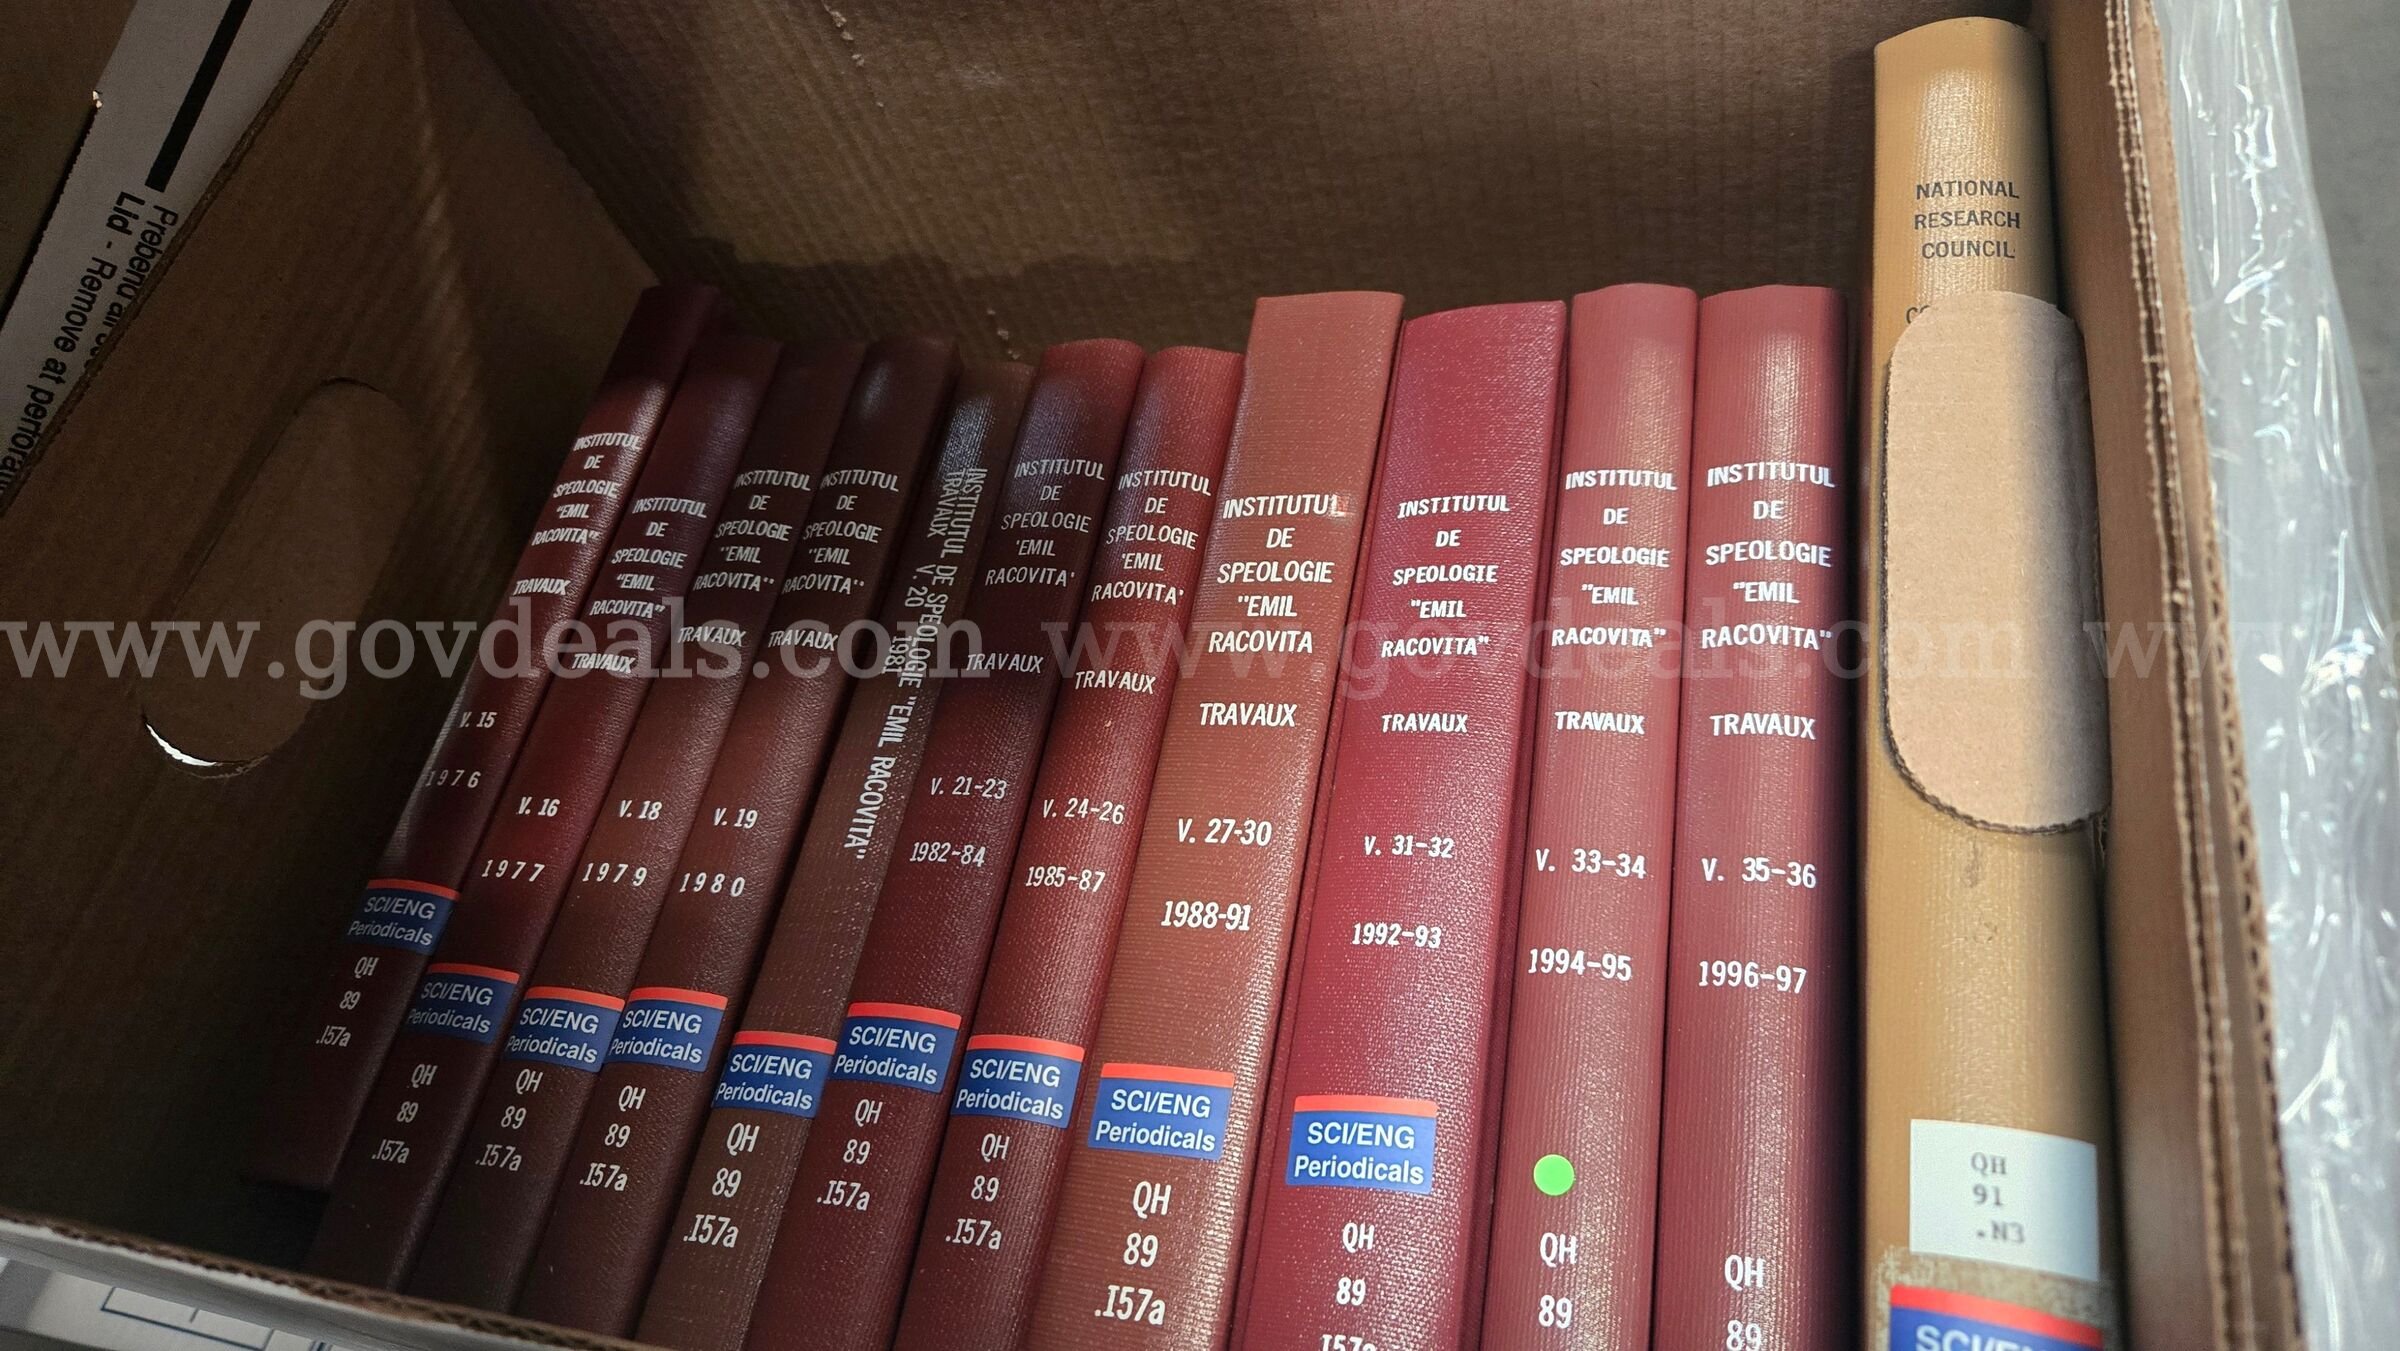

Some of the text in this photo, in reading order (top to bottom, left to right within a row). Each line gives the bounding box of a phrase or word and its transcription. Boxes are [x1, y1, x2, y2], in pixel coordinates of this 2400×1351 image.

[1916, 180, 2020, 200] NATIONAL
[106, 191, 146, 236] Lid
[1914, 210, 2021, 230] RESEARCH
[117, 205, 178, 300] Prebend
[1921, 240, 2016, 259] COUNCIL
[54, 257, 118, 352] Remove
[39, 357, 67, 385] at
[573, 432, 641, 451] INSTITUTUL
[584, 455, 602, 469] DE
[1014, 458, 1105, 481] INSTITUTUL
[1707, 461, 1835, 488] INSTITUTUL
[552, 480, 620, 499] SPEOLOGIE
[734, 469, 811, 491] INSTITUTUL
[820, 470, 898, 492] INSTITUTUL
[1118, 470, 1211, 496] INSTITUTUL
[1565, 469, 1678, 490] INSTITUTUL
[751, 494, 771, 510] DE
[836, 494, 857, 511] DE
[1040, 485, 1062, 501] DE
[1144, 497, 1168, 514] DE
[632, 497, 707, 519] INSTITUTUL
[940, 468, 987, 558] INSTITUTUL
[1222, 494, 1346, 520] INSTITUTUL
[1397, 494, 1510, 520] INSTITUTUL
[1603, 507, 1630, 525] DE
[1753, 500, 1785, 520] DE
[646, 522, 668, 537] DE
[715, 520, 793, 542] SPEOLOGIE
[803, 520, 881, 543] SPEOLOGIE
[1001, 512, 1091, 533] SPEOLOGIE
[904, 469, 966, 608] TRAVAUX 20
[1106, 524, 1199, 550] SPEOLOGIE
[1266, 528, 1294, 549] DE
[1435, 529, 1461, 548] DE
[611, 548, 687, 568] SPEOLOGIE
[1560, 546, 1671, 568] SPEOLOGIE
[1705, 540, 1832, 568] SPEOLOGIE
[935, 564, 958, 586] DE
[1216, 560, 1335, 584] SPEOLOGIE
[1392, 564, 1499, 586] SPEOLOGIE
[513, 579, 569, 596] TRAVAUX
[677, 626, 746, 647] TRAVAUX
[767, 630, 838, 651] TRAVAUX
[898, 593, 948, 688] SPEOLOGIE
[571, 653, 636, 673] TRAVAUX
[966, 653, 1043, 673] TRAVAUX
[1075, 670, 1156, 695] TRAVAUX
[459, 711, 497, 728] V. 15
[1200, 702, 1298, 727] TRAVAUX
[1381, 714, 1468, 733] TRAVAUX
[1555, 710, 1645, 735] TRAVAUX
[1710, 712, 1816, 740] TRAVAUX
[425, 769, 481, 789] 1976
[931, 776, 1007, 800] V. 21-23
[518, 797, 560, 817] V. 16
[618, 800, 662, 820] V. 18
[713, 808, 758, 829] V. 19
[1043, 798, 1125, 825] V. 24-26
[1177, 818, 1273, 847] V. 27-30
[910, 842, 986, 867] 1982-84
[1364, 834, 1455, 859] V. 31-32
[482, 859, 545, 882] 1977
[582, 863, 648, 887] 1979
[1535, 847, 1647, 880] V. 33-34
[1701, 856, 1817, 889] V. 35-36
[679, 872, 745, 897] 1980
[1026, 866, 1106, 893] 1985-87
[364, 897, 436, 920] SCI/ENG
[1160, 900, 1252, 932] 1988-91
[349, 921, 433, 946] Periodicals
[1351, 922, 1442, 949] 1992-93
[354, 957, 378, 978] QH
[1528, 948, 1632, 982] 1994-95
[1698, 960, 1807, 994] 1996-97
[339, 991, 360, 1010] 89
[421, 982, 493, 1006] SCI/ENG
[407, 1008, 490, 1034] Periodicals
[520, 1008, 599, 1035] SCI/ENG
[623, 1009, 702, 1035] SCI/ENG
[506, 1034, 597, 1064] Periodicals
[609, 1038, 702, 1064] Periodicals
[849, 1026, 936, 1054] SCI/ENG
[411, 1064, 437, 1088] QH
[730, 1053, 812, 1080] SCI/ENG
[834, 1055, 938, 1085] Periodicals
[970, 1058, 1061, 1088] SCI/ENG
[516, 1069, 543, 1094] QH
[618, 1085, 646, 1112] QH
[716, 1082, 814, 1110] Periodicals
[956, 1089, 1064, 1120] Periodicals
[1110, 1089, 1211, 1118] SCI/ENG
[397, 1101, 418, 1123] 89
[501, 1106, 526, 1129] 89
[855, 1099, 883, 1127] QH
[604, 1123, 630, 1148] 89
[727, 1123, 760, 1156] QH
[981, 1133, 1009, 1162] QH
[1095, 1120, 1216, 1152] Periodicals
[1307, 1121, 1415, 1149] SCI/ENG
[843, 1139, 871, 1165] 89
[1970, 1152, 2007, 1177] QH
[1294, 1155, 1424, 1185] Periodicals
[712, 1168, 742, 1198] 89
[970, 1175, 999, 1202] 89
[1972, 1183, 2004, 1207] 91
[1132, 1180, 1172, 1220] QH
[1342, 1222, 1375, 1254] QH
[1977, 1220, 2025, 1244] .N3
[1123, 1232, 1159, 1268] 89
[1539, 1232, 1577, 1268] QH
[1724, 1254, 1765, 1292] QH
[1336, 1277, 1366, 1307] 89
[1538, 1294, 1573, 1329] 89
[1726, 1319, 1762, 1351] 89
